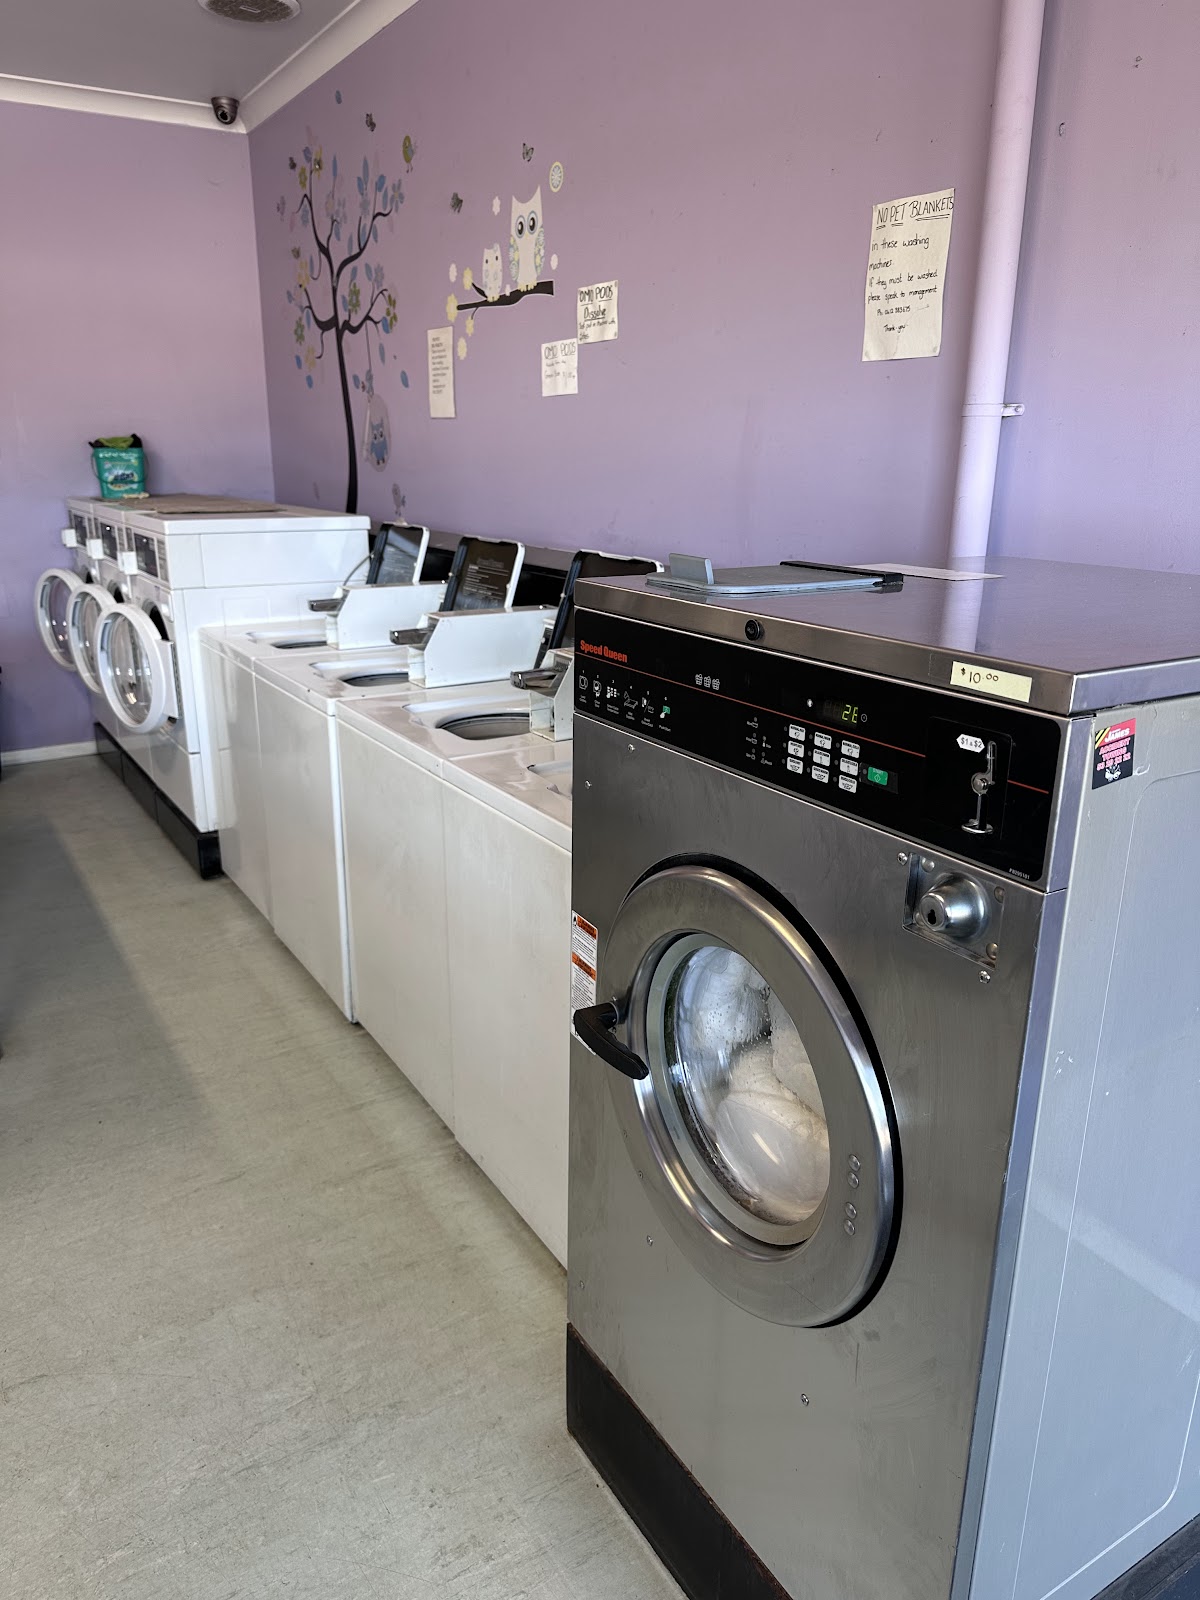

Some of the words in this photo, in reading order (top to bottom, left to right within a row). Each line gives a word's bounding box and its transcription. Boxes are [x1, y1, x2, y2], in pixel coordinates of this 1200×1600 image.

[876, 206, 889, 225] NO
[889, 202, 908, 223] PET
[909, 197, 955, 218] BLANKETS
[871, 240, 879, 252] in
[880, 237, 898, 250] these
[902, 233, 930, 250] washing
[875, 275, 888, 290] they
[888, 272, 903, 285] must
[907, 272, 914, 282] be
[917, 268, 938, 281] washed
[899, 290, 906, 298] to
[580, 640, 603, 654] Speed
[604, 646, 628, 663] Queen
